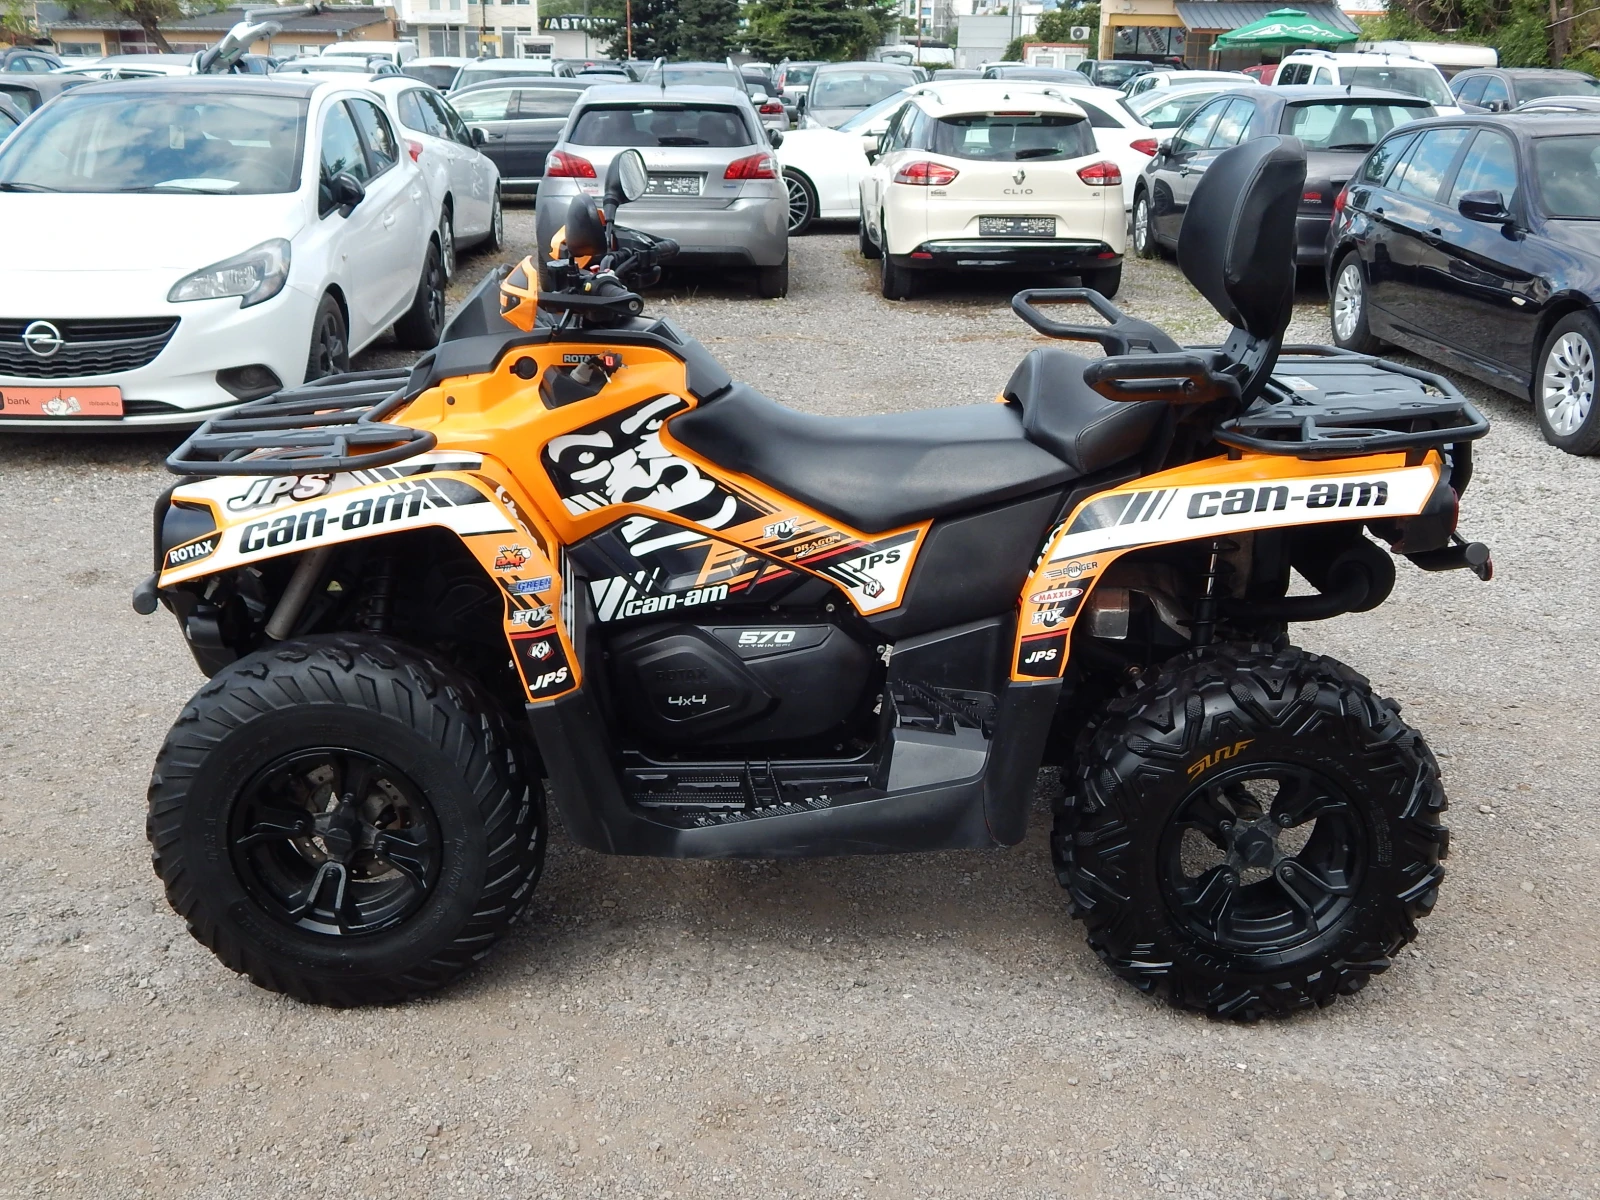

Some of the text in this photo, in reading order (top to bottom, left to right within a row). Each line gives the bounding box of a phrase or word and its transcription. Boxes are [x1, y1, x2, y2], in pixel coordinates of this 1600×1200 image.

[563, 354, 593, 363] ROTA
[7, 396, 31, 405] bank
[226, 474, 335, 512] JPS
[1186, 480, 1389, 520] can-am
[238, 486, 426, 554] can-am
[169, 539, 214, 564] ROTAX
[793, 533, 841, 554] DRAGON
[852, 549, 901, 573] JPS
[625, 583, 730, 617] can-am
[1038, 589, 1074, 602] MAXXIS
[738, 630, 796, 644] 570
[1024, 648, 1058, 664] JPS
[528, 666, 568, 691] JPS
[667, 694, 708, 707] 4x4
